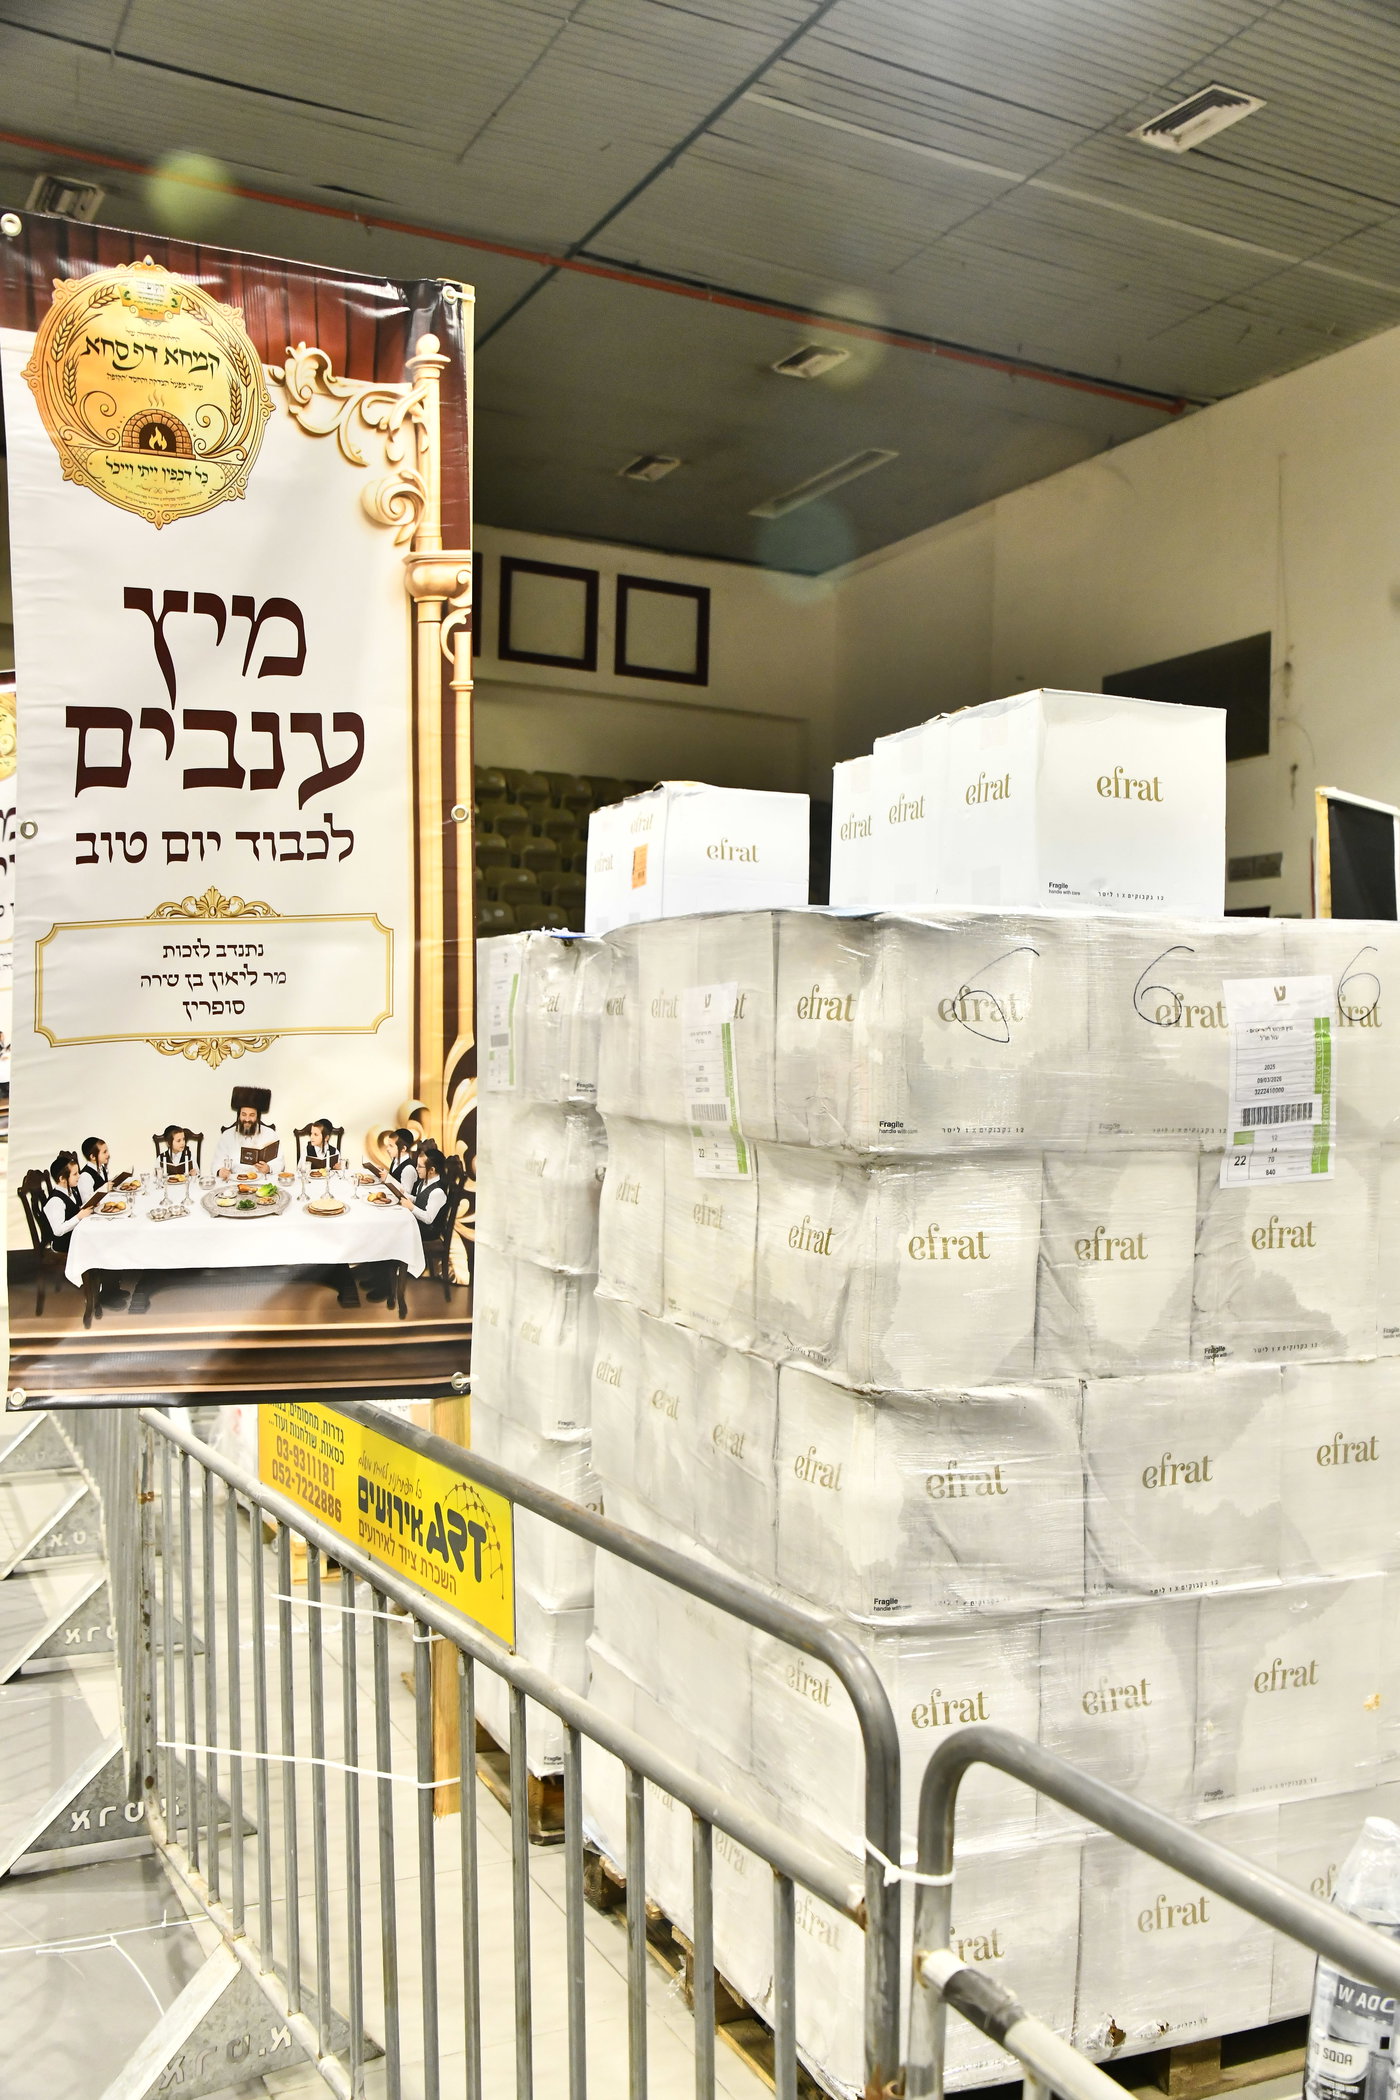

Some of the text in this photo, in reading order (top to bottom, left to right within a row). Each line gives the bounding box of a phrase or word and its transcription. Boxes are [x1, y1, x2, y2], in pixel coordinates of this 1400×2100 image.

[80, 336, 220, 380] קמחא דפסחא
[123, 586, 307, 711] מיץ
[65, 705, 365, 811] ענבים
[965, 770, 1012, 806] efrat
[1095, 764, 1165, 804] efrat
[840, 812, 873, 842] efrat
[888, 792, 926, 826] efrat
[75, 812, 355, 866] לכבוד יום טוב
[706, 837, 761, 864] efrat
[1049, 881, 1069, 889] Fragile
[162, 937, 265, 959] נתנדב לזכות
[140, 961, 287, 993] מר ליאון בן שרה
[1133, 945, 1195, 1027] 6
[1337, 946, 1381, 1022] 6
[182, 998, 246, 1022] סופרין
[651, 986, 679, 1020] efrat
[796, 983, 857, 1023] efrat
[937, 984, 1024, 1023] efrat
[1155, 992, 1229, 1030] efrat
[1336, 992, 1383, 1029] frat
[879, 1120, 904, 1129] Fragile
[1233, 1155, 1247, 1166] 22
[615, 1172, 642, 1206] efrat
[692, 1193, 725, 1231] efrat
[788, 1214, 834, 1257] efrat
[908, 1222, 991, 1261] efrat
[1074, 1225, 1149, 1262] efrat
[1250, 1214, 1317, 1251] efrat
[289, 1422, 317, 1449] שולחנות
[1316, 1431, 1380, 1467] efrat
[276, 1435, 335, 1491] 03-9311181
[793, 1445, 844, 1493] efrat
[926, 1459, 1009, 1500] efrat
[1141, 1452, 1214, 1489] efrat
[271, 1458, 342, 1524] 052-7222886
[358, 1518, 457, 1596] השכרת ציוד לאירועים
[426, 1501, 487, 1583] ART
[874, 1597, 899, 1606] Fragile
[784, 1657, 833, 1708] efrat
[1253, 1657, 1319, 1694] efrat
[911, 1688, 991, 1730] efrat
[1081, 1676, 1153, 1716] efrat
[1137, 1893, 1210, 1933] efrat
[949, 1926, 1006, 1964] rat
[1322, 2047, 1353, 2067] SODA
